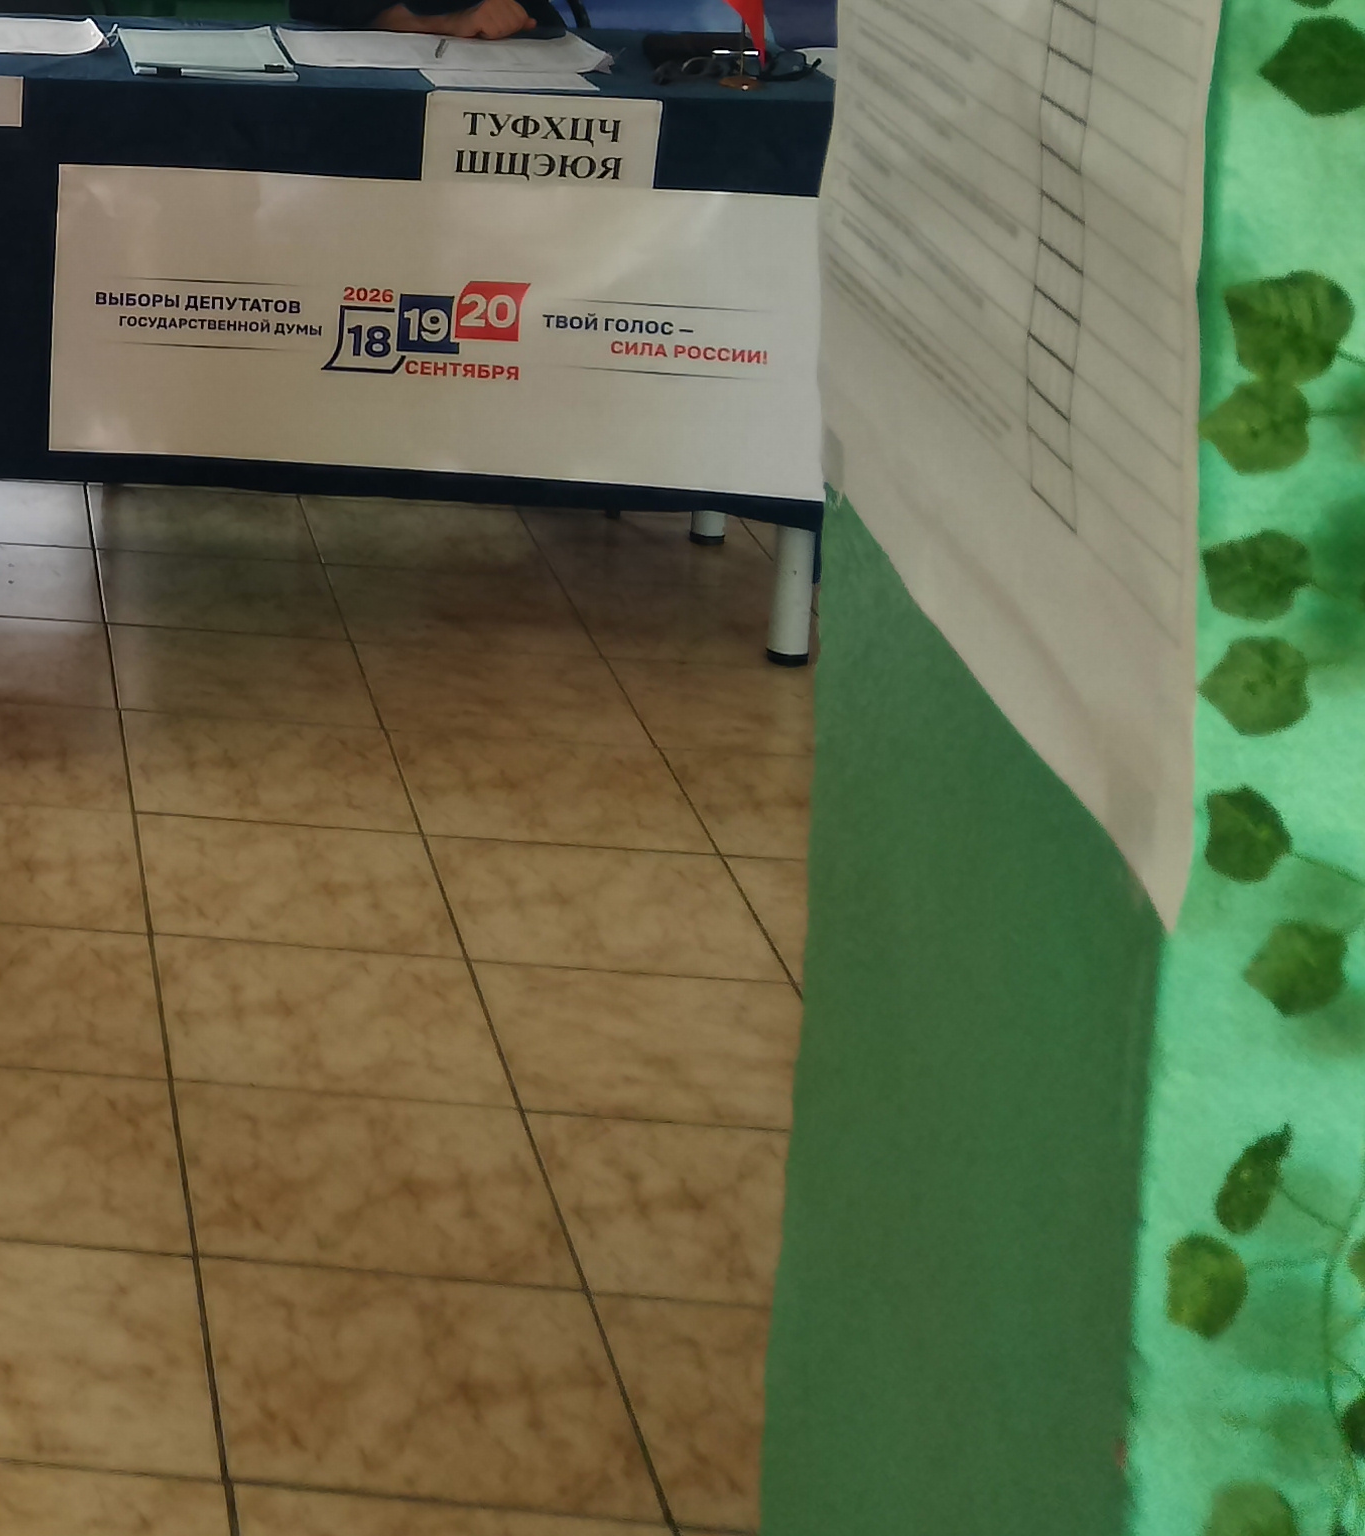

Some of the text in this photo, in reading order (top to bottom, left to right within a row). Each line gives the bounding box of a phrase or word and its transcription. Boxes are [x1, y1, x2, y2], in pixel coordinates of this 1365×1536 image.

[463, 111, 622, 148] ТУФХЦЧ
[454, 149, 623, 181] ШЩЭЮЯ
[94, 291, 301, 314] ВЫБОРЫ ДЕПУТАТОВ
[343, 286, 394, 303] 2026
[459, 293, 518, 329] 20
[118, 315, 323, 337] ГОСУДАРСТВЕННОЙ ДУМЫ
[403, 308, 450, 343] 19
[542, 313, 598, 331] ТВОЙ
[604, 317, 674, 335] ГОЛОС
[347, 324, 392, 358] 18
[610, 340, 769, 365] СИЛА РОССИИ!
[404, 360, 519, 381] СЕНТЯБРЯ
